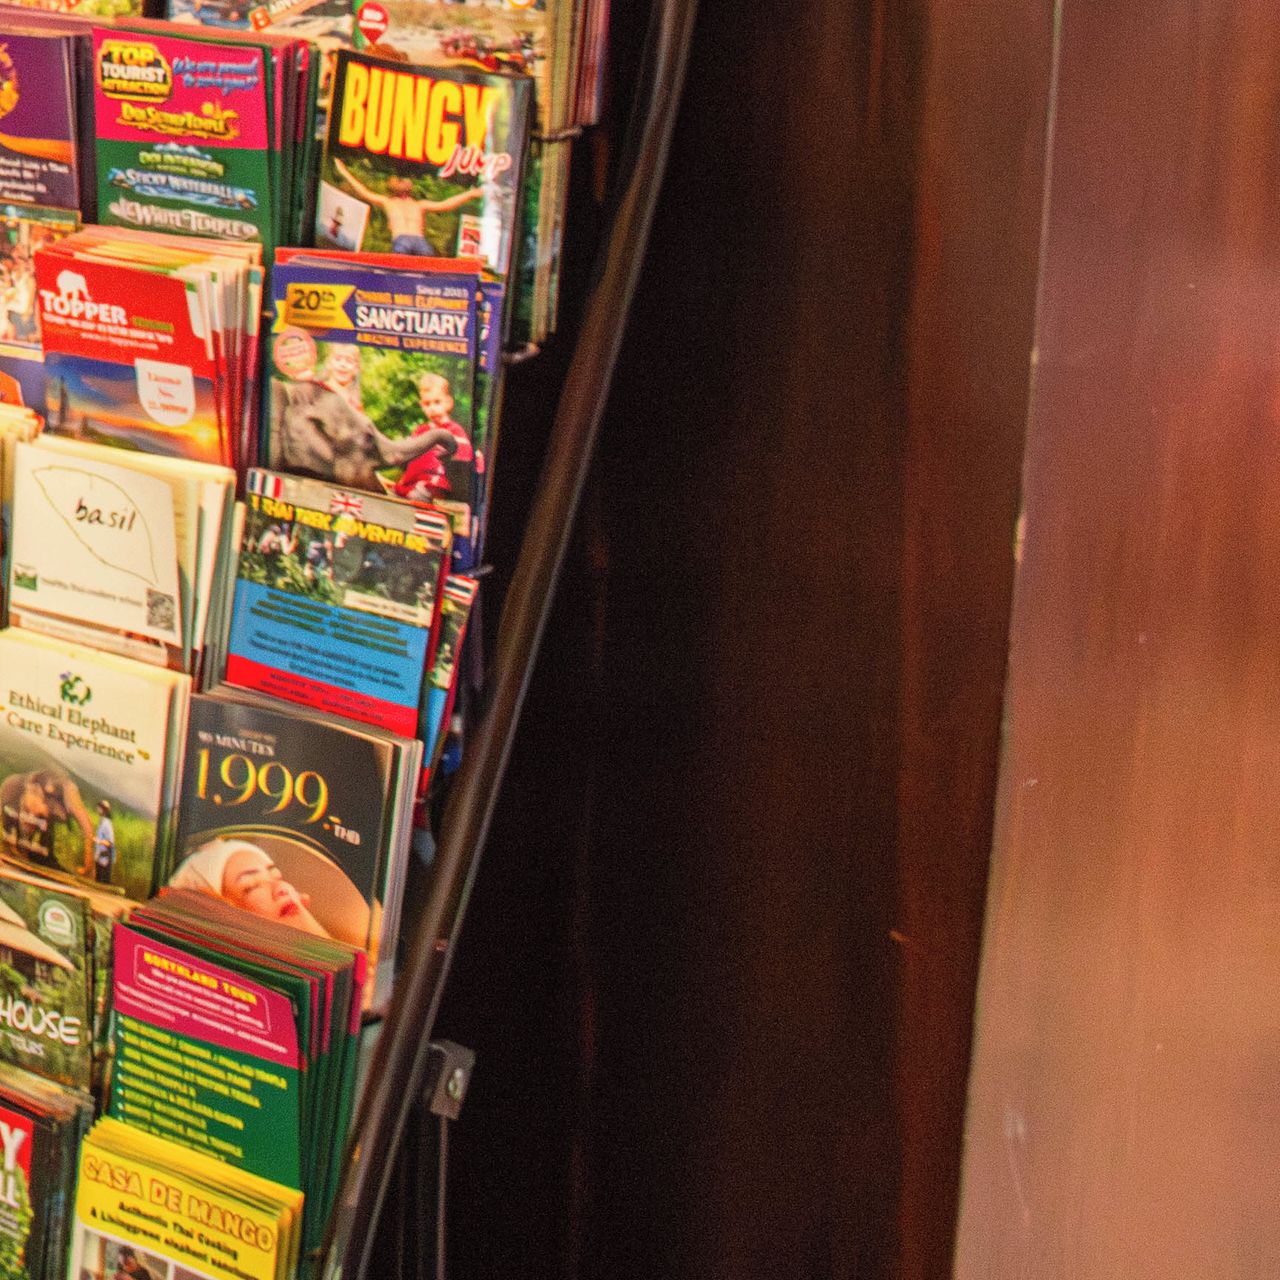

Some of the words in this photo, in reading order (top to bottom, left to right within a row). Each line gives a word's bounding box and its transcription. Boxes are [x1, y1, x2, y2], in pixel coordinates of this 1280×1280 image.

[101, 61, 167, 83] TOURIST
[107, 46, 156, 65] TOP
[339, 60, 500, 167] BUNGY
[40, 289, 128, 326] TOPPER
[355, 305, 470, 339] SANCTUARY
[75, 497, 137, 533] basil
[294, 506, 332, 533] TREK
[332, 515, 429, 554] ADVENTURE
[7, 690, 64, 720] Ethical
[65, 705, 137, 743] Elephant
[6, 710, 43, 736] Care
[46, 718, 136, 764] Experience
[214, 733, 276, 757] MINUTES
[143, 951, 218, 991] NORTHLAND
[221, 982, 257, 1006] TOUR
[82, 1153, 144, 1200] CASA
[149, 1179, 182, 1214] DE
[188, 1193, 276, 1253] MANGO
[196, 1233, 239, 1262] Cooking
